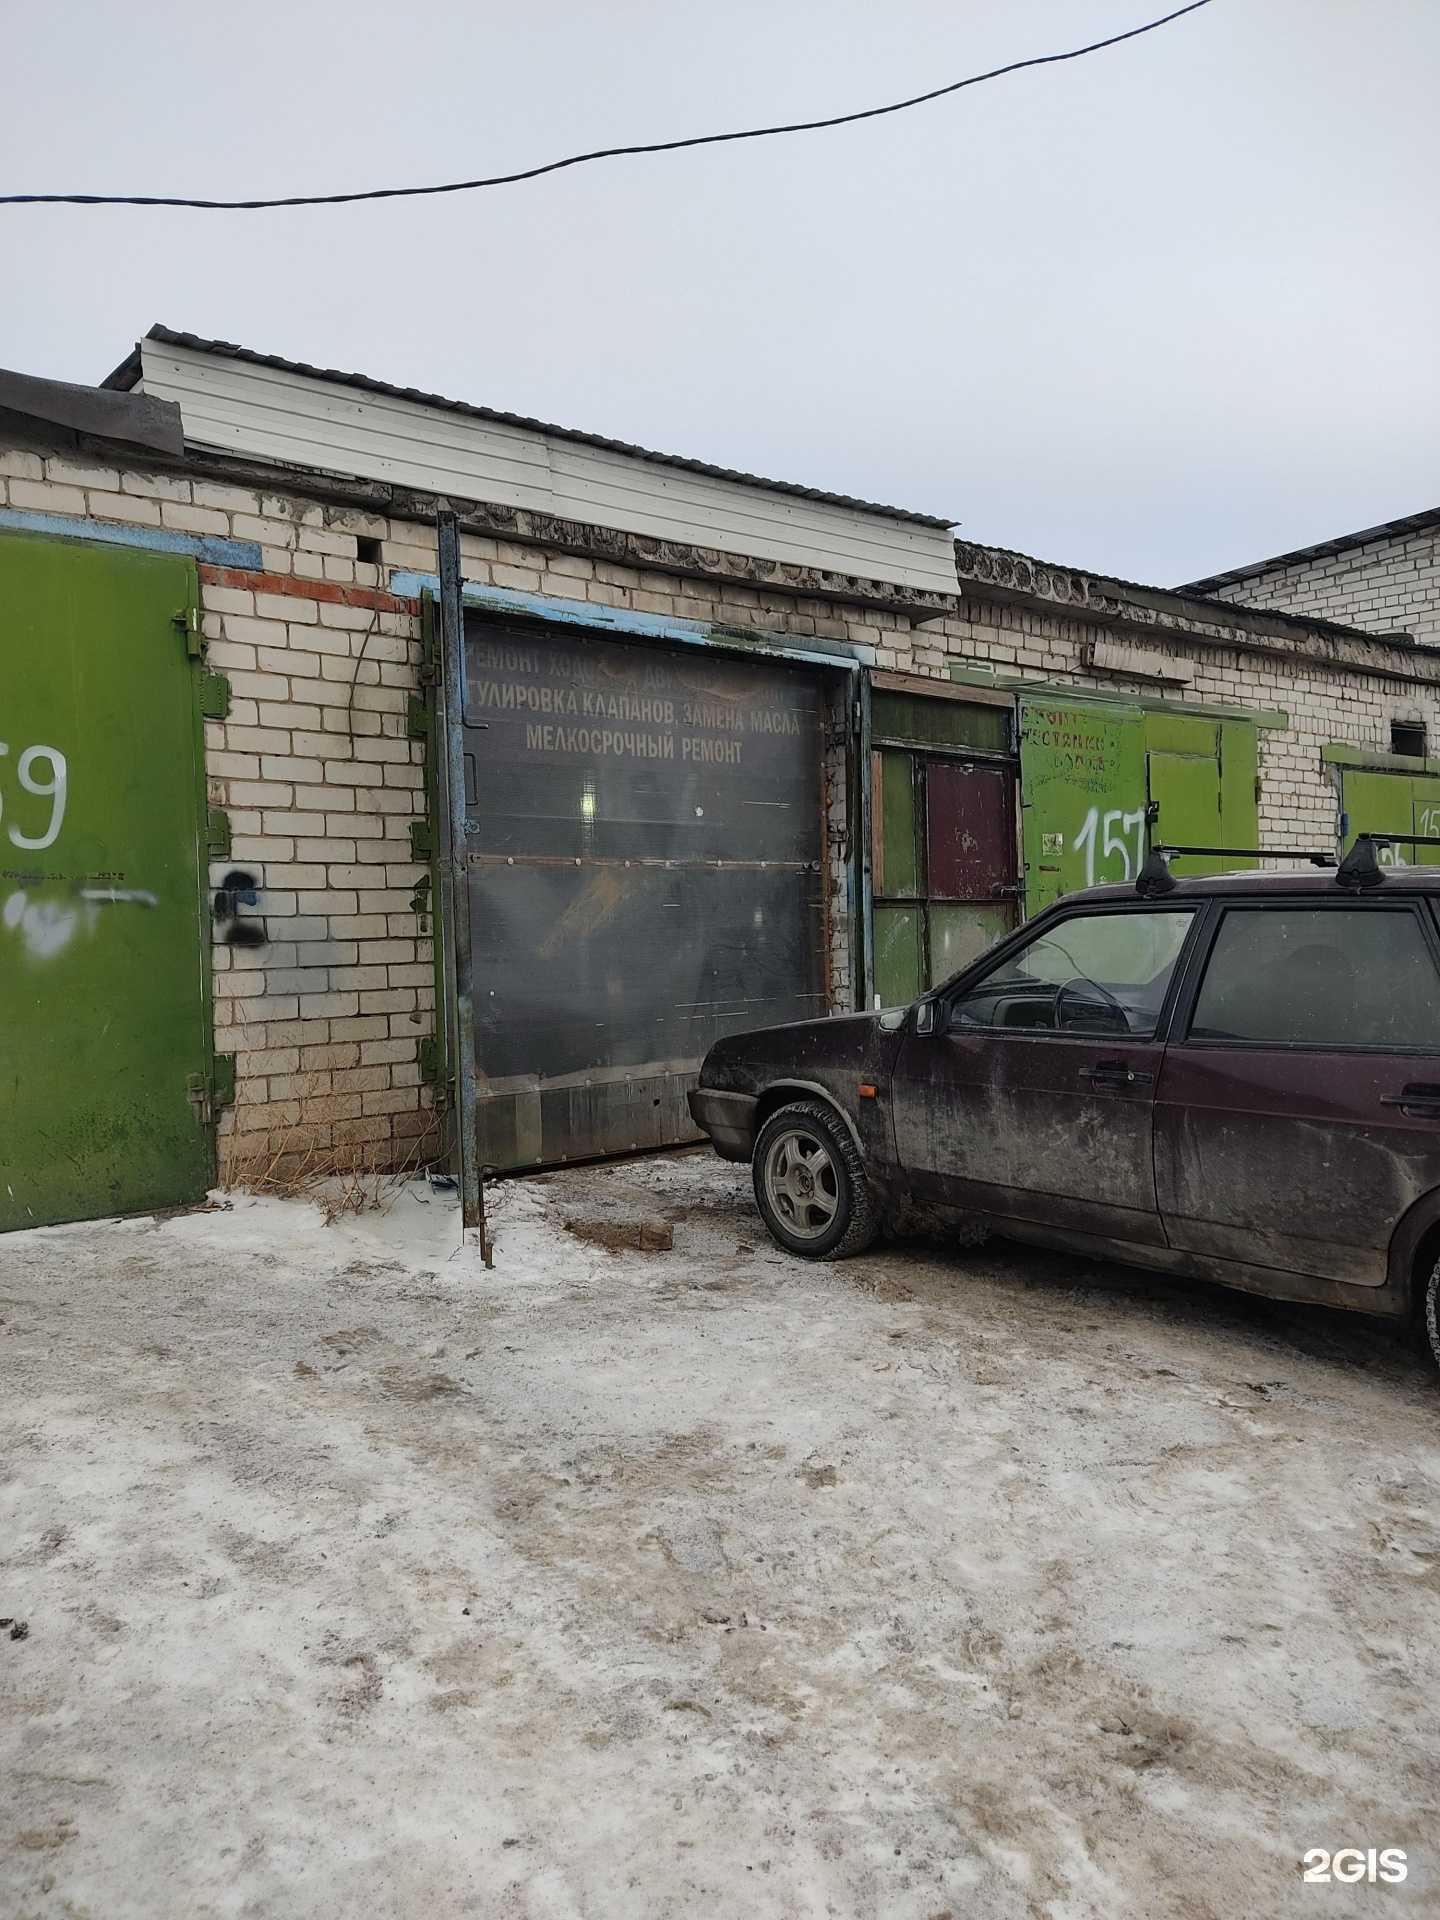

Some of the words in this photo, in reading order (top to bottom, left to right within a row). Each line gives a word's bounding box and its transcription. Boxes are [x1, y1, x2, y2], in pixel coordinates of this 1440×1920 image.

[526, 723, 674, 759] МЕЛКОСРОЧНЫЙ
[682, 736, 743, 763] РЕМОНТ
[682, 703, 745, 731] ЗАМЕНА
[750, 711, 801, 737] МАСЛА
[0, 742, 68, 850] 9
[1072, 806, 1146, 887] 157
